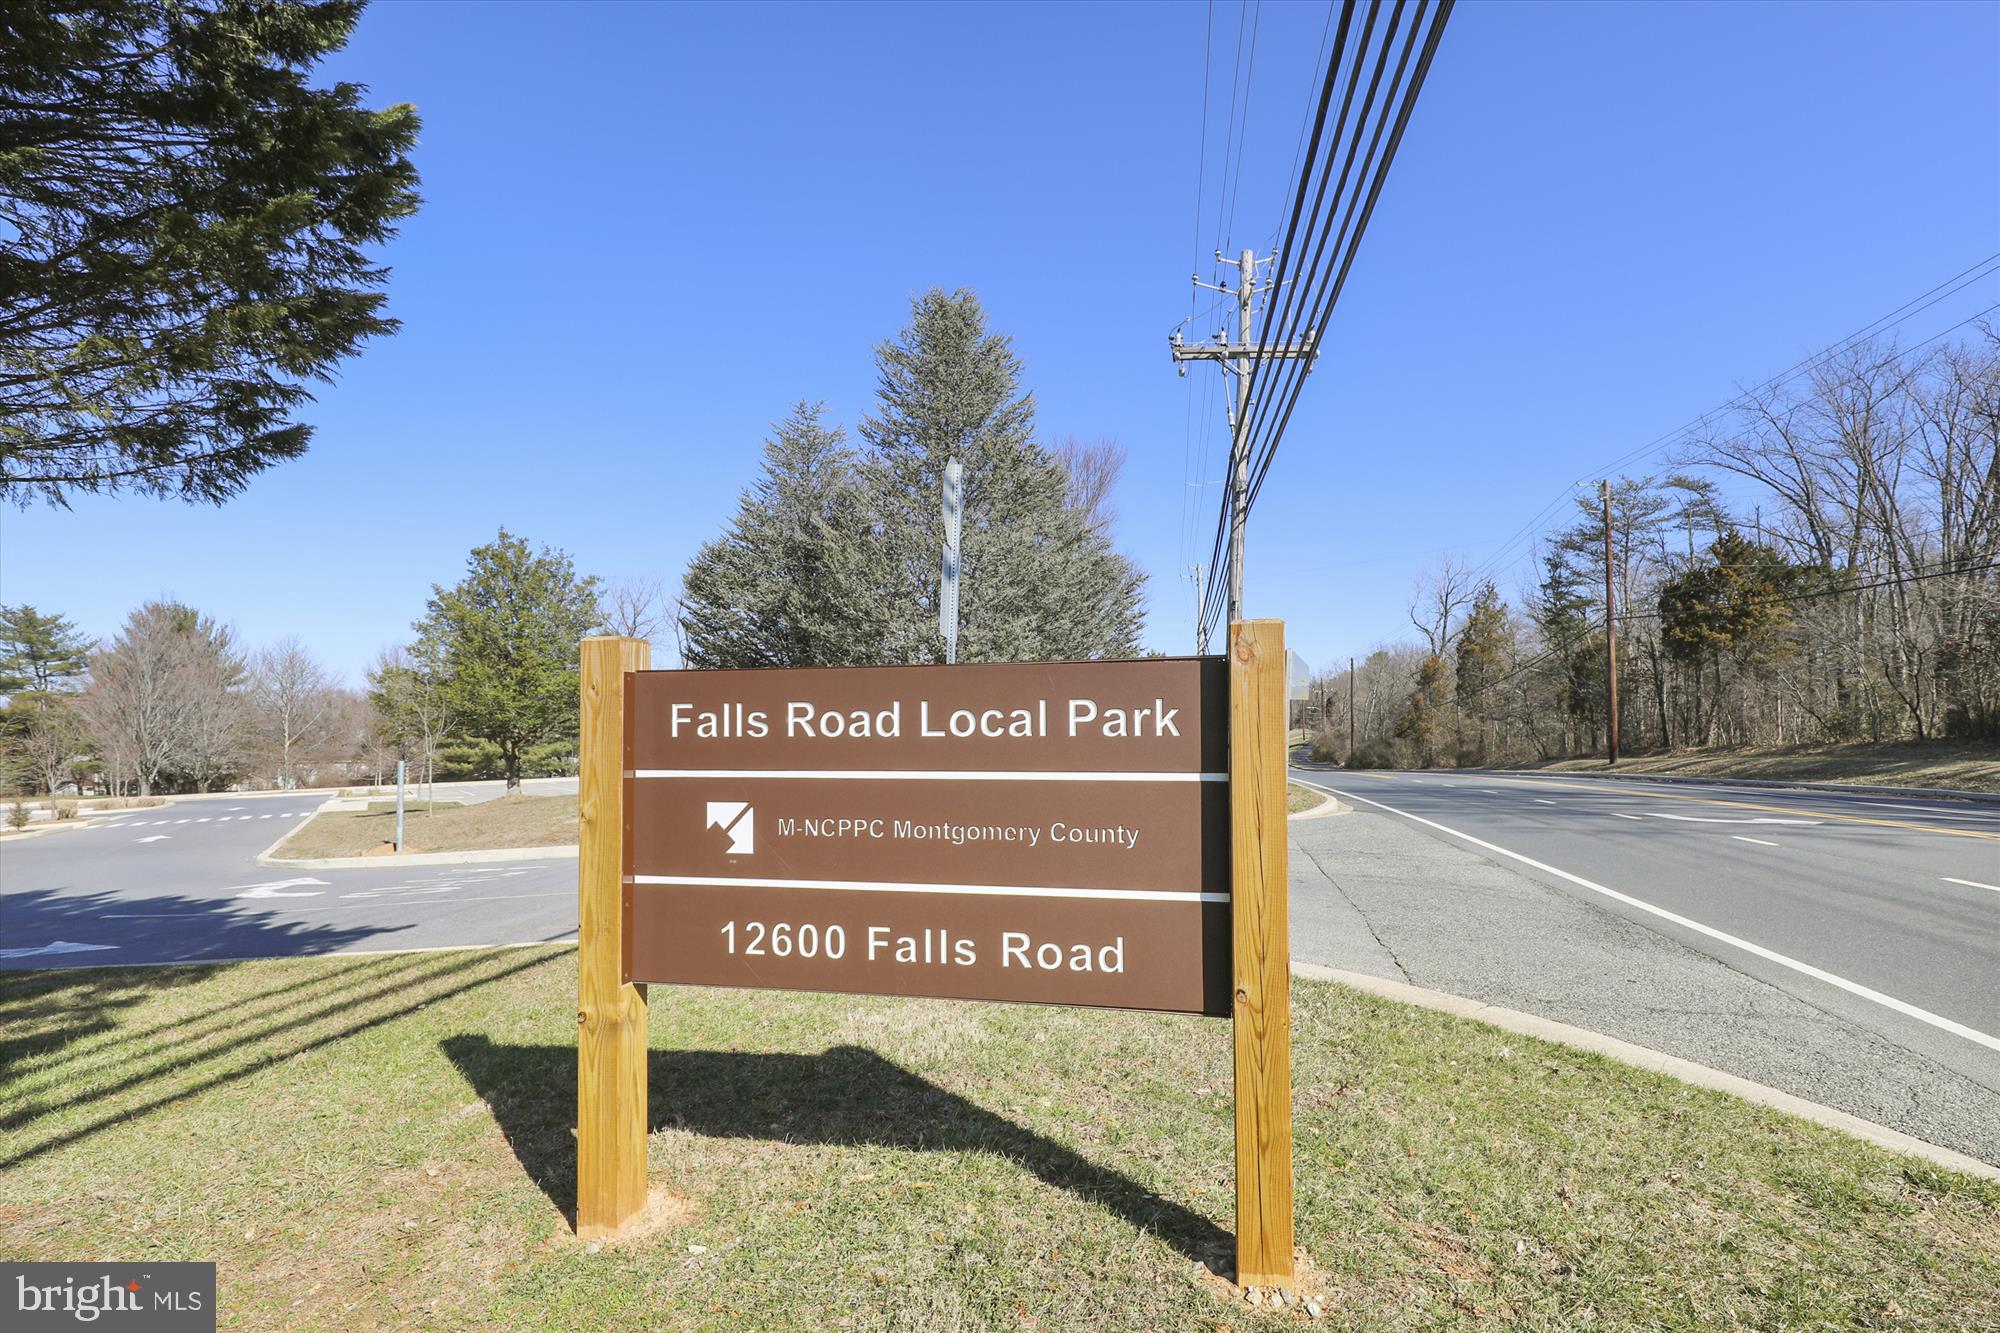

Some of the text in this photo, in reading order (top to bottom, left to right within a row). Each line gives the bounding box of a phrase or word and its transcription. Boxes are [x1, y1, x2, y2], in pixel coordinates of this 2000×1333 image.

[671, 698, 1181, 738] Falls Road Local Park
[777, 818, 1139, 849] M-NCPPC Montgomery County
[720, 920, 1124, 973] 12600 Falls Road
